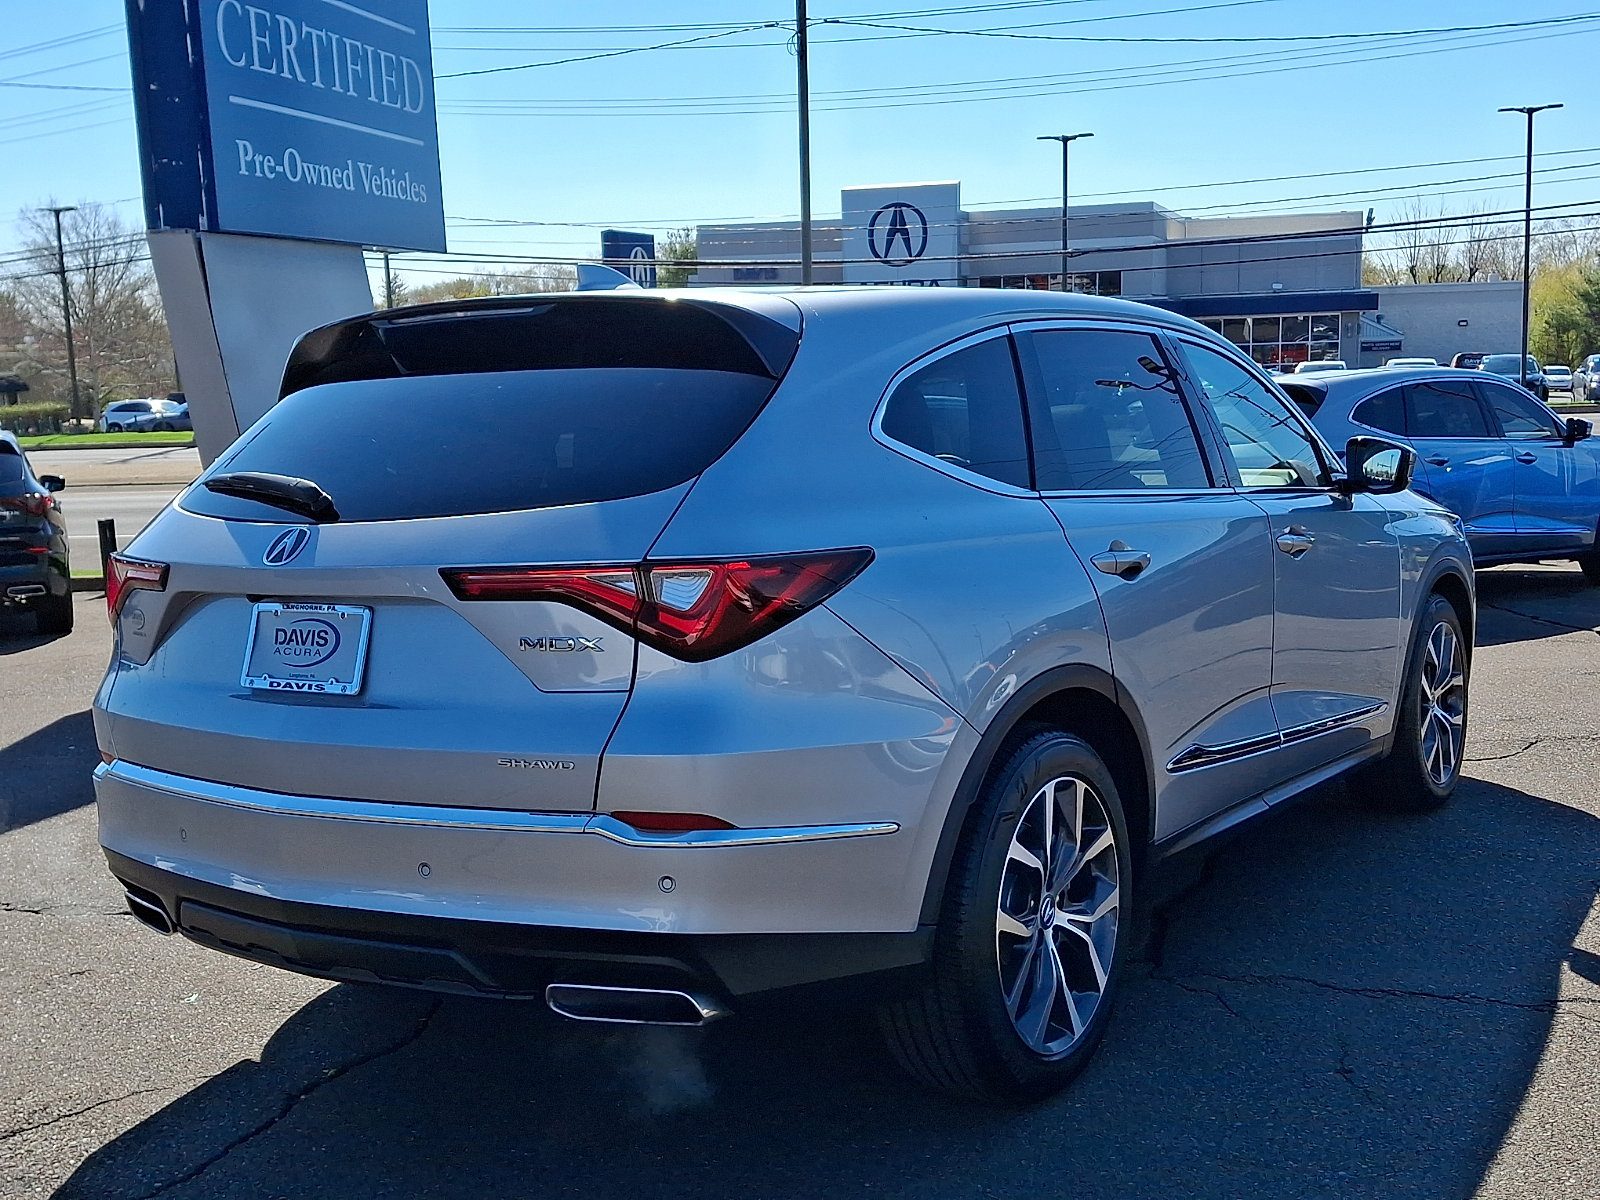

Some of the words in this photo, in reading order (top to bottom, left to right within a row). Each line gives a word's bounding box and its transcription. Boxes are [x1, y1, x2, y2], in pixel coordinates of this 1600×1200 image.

[216, 0, 424, 114] CERTIFIED
[235, 139, 356, 191] Pre-Owned
[357, 161, 428, 204] Vehicles
[274, 628, 329, 647] DAVIS
[519, 636, 605, 652] MDX
[273, 647, 322, 657] ACURA
[268, 681, 326, 691] DAVIS
